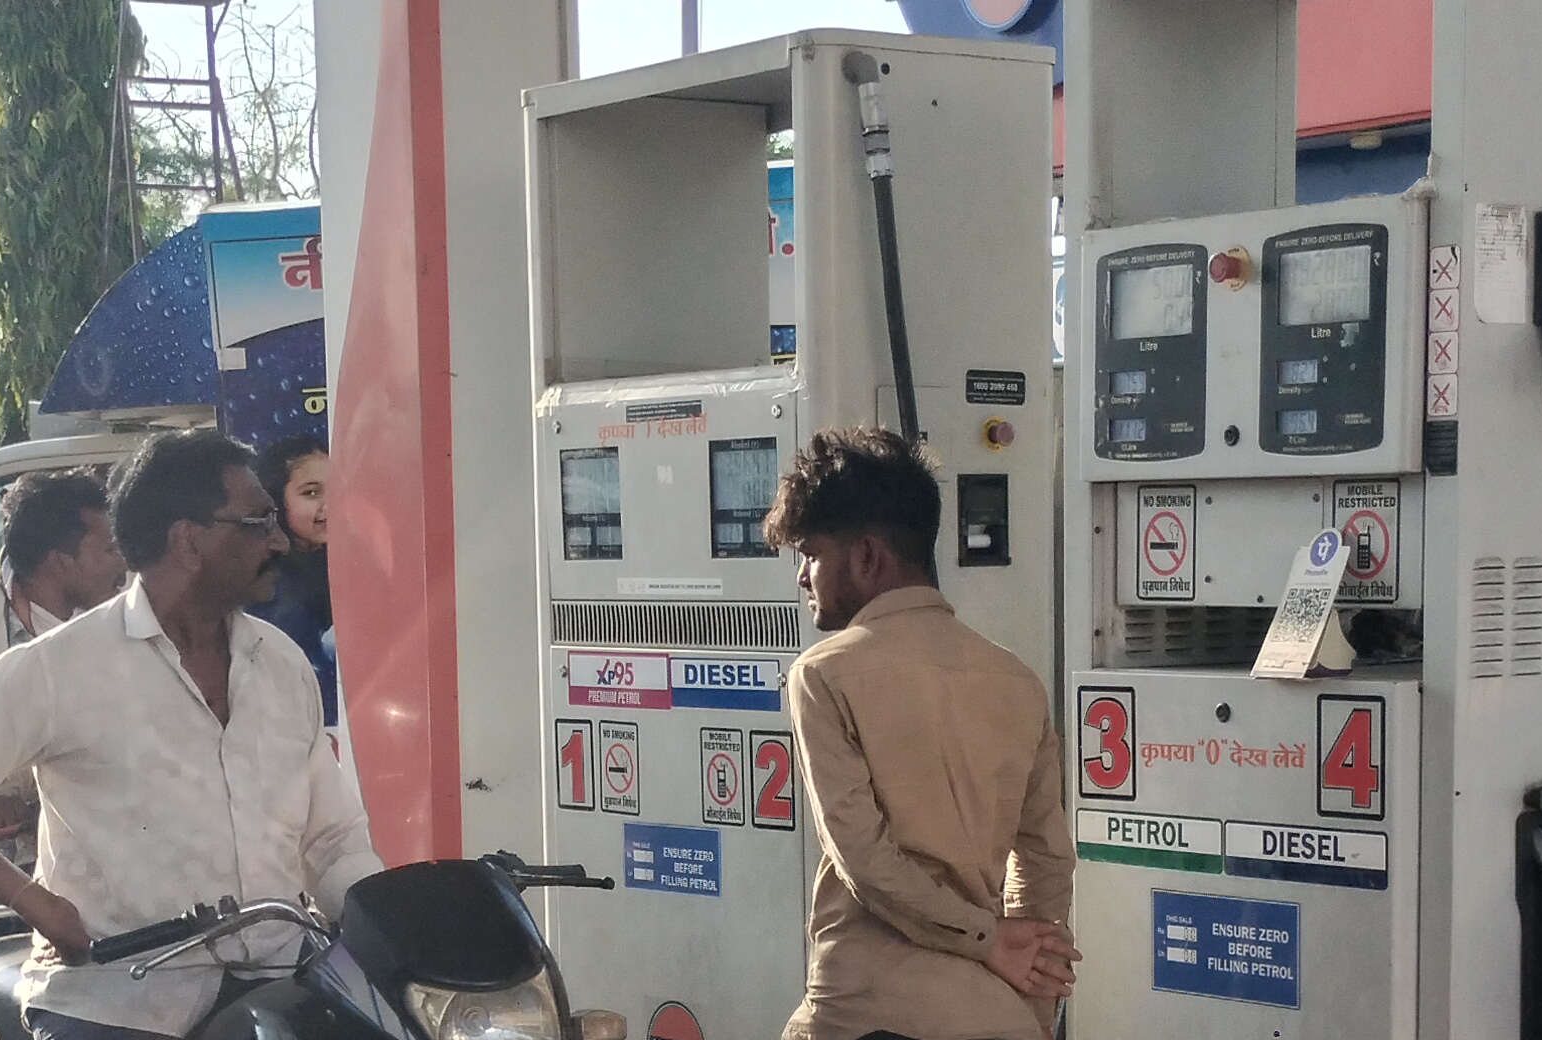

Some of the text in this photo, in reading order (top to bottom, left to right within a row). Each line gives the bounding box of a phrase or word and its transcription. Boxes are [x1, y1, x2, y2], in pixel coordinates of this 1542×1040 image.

[1311, 327, 1331, 339] Litre
[1140, 341, 1158, 352] Litre
[1347, 485, 1383, 496] MOBILE
[1143, 495, 1191, 508] NO SMOKING
[1339, 497, 1396, 509] RESTRICTED
[684, 663, 766, 688] DIESEL
[588, 690, 642, 706] PREMIUM PETROL
[603, 728, 635, 741] NO SMOKING
[709, 732, 732, 742] MOBILE
[1083, 696, 1132, 790] 3
[704, 742, 741, 753] RESTRICTED
[1140, 742, 1195, 768] कृपया
[1229, 740, 1268, 767] देख
[1273, 742, 1307, 769] लेवें
[561, 729, 586, 804] 1
[1322, 707, 1378, 809] 4
[754, 738, 793, 821] 2
[1107, 816, 1189, 848] PETROL
[662, 847, 714, 862] ENSURE ZERO
[1262, 829, 1346, 863] DIESEL
[673, 862, 704, 876] BEFORE
[660, 874, 718, 892] FILLING PETROL
[1212, 922, 1290, 944] ENSURE ZERO
[1228, 942, 1273, 960] BEFORE
[1208, 957, 1294, 981] FILLING PETROL
